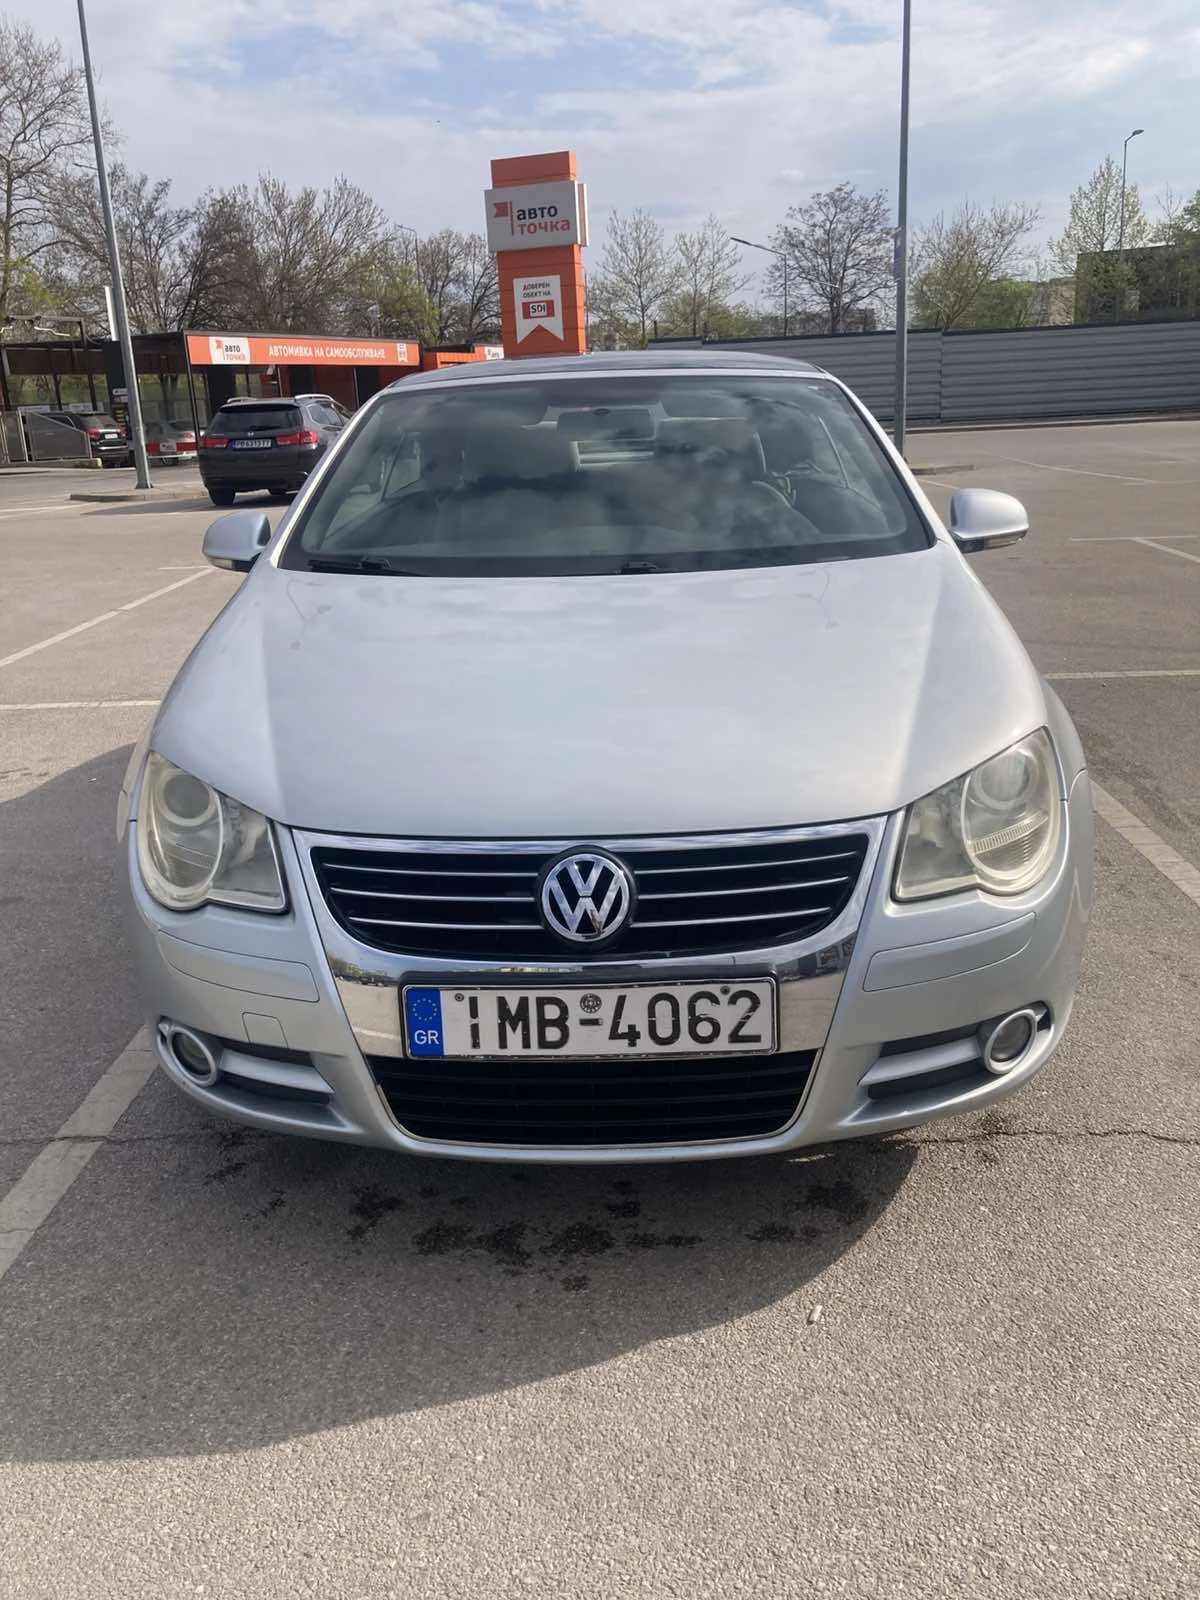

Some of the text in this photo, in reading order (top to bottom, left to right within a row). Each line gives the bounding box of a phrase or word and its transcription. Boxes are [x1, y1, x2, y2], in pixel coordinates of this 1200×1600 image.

[516, 205, 558, 221] авто
[517, 219, 571, 235] точка
[531, 304, 546, 314] SDI
[224, 344, 241, 353] авто
[268, 345, 314, 358] АВТОМИВКА
[314, 346, 325, 358] НА
[225, 353, 246, 361] точка
[414, 1030, 440, 1045] GR
